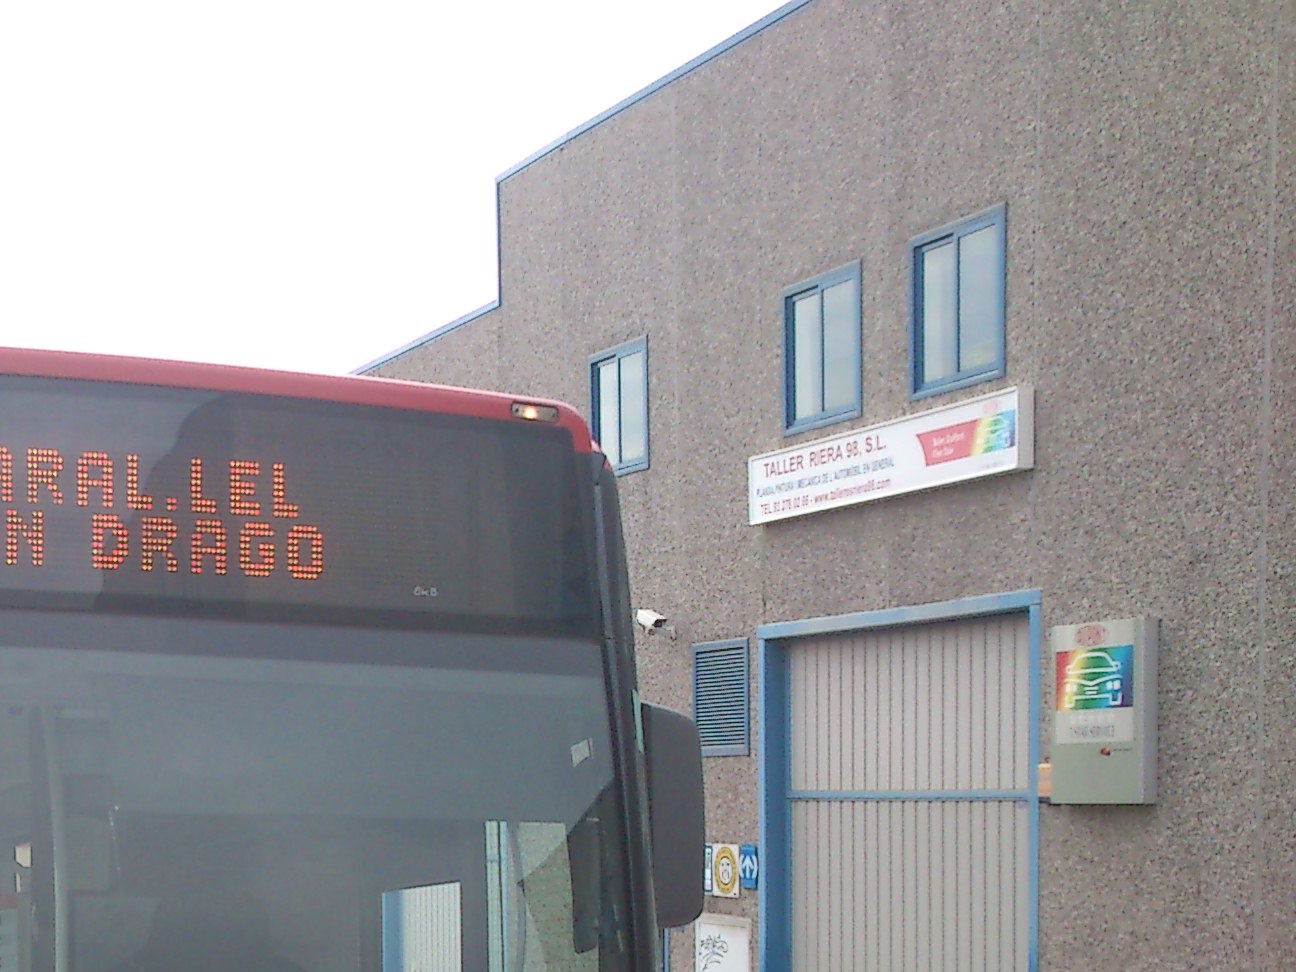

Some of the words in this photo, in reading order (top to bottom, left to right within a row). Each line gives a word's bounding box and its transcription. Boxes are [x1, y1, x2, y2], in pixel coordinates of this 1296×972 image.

[764, 455, 804, 478] TALLER
[809, 445, 843, 468] RIERA
[865, 435, 887, 453] S.L.
[92, 514, 324, 580] DRAGO
